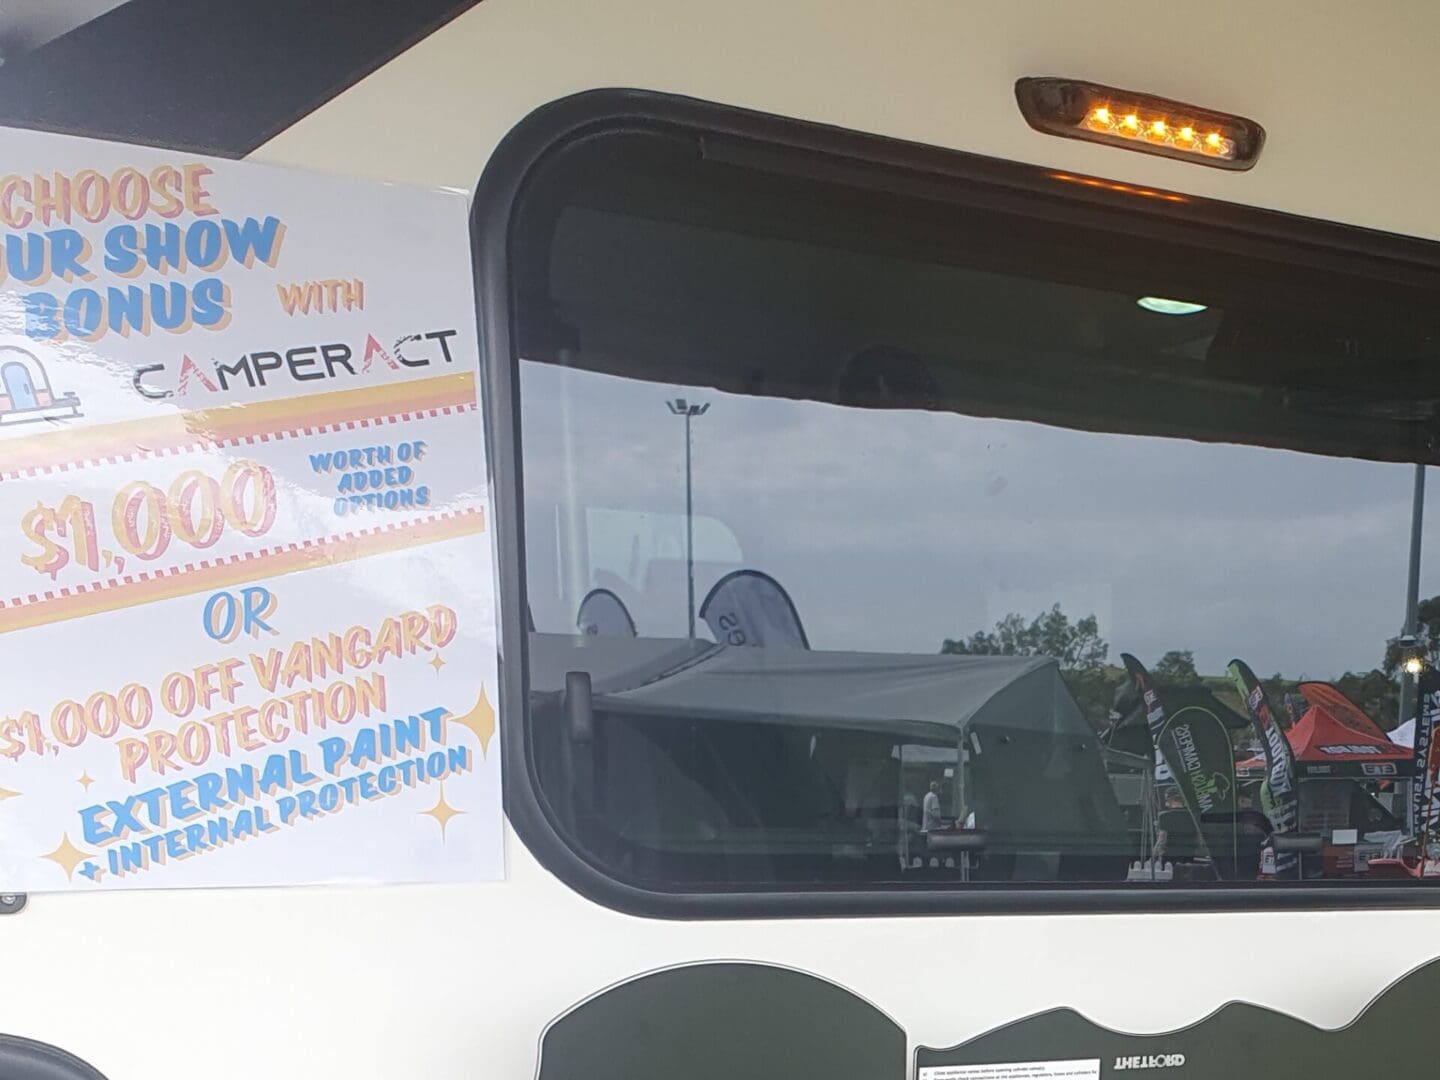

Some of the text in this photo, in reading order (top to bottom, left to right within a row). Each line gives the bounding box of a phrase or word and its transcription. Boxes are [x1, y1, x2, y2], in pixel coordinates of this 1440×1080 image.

[0, 163, 220, 230] CHOOSE
[0, 216, 287, 284] UR SHOW
[24, 277, 364, 343] BONUS WITH
[133, 329, 458, 399] CAMPERACT
[309, 440, 428, 473] WORTH OF
[337, 465, 414, 494] ADDED
[21, 459, 277, 580] $1,000
[333, 486, 430, 516] OPTIONS
[203, 585, 281, 645] OR
[0, 683, 153, 761] $1,000
[160, 656, 245, 718] OFF
[116, 672, 387, 784] PROTECTION
[78, 706, 455, 846] EXTERNAL PAINT
[106, 805, 278, 877] INTERNAL
[276, 745, 473, 823] PROTECTION
